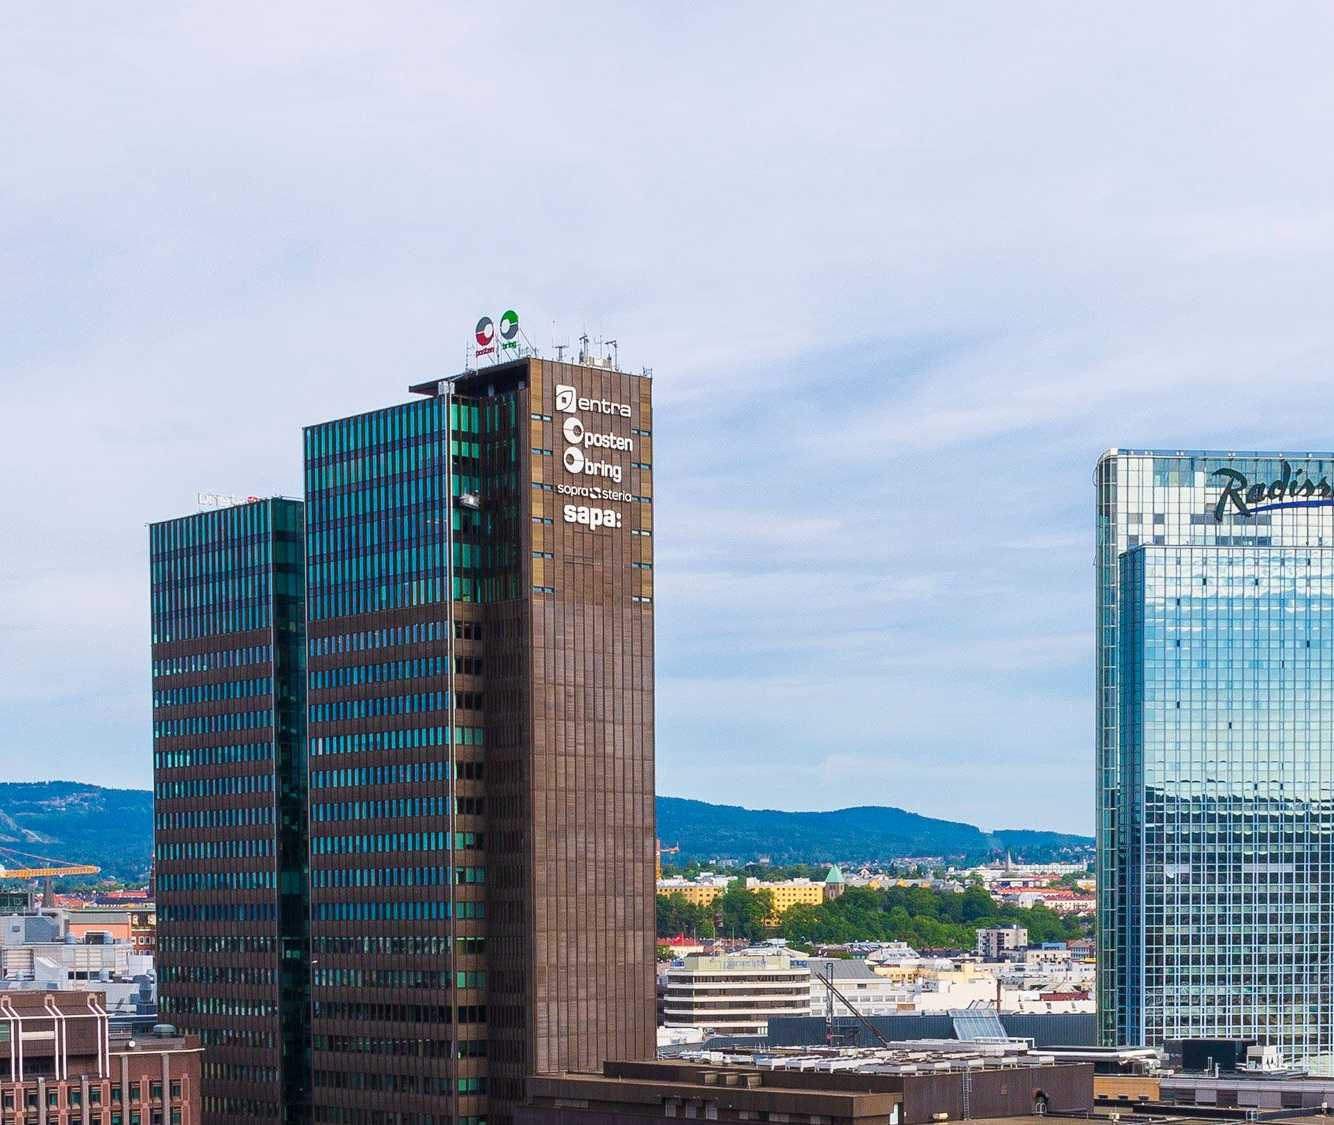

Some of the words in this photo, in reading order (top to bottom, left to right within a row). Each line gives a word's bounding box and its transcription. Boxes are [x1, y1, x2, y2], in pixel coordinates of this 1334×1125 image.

[578, 397, 631, 417] entra
[584, 432, 633, 452] posten
[584, 457, 622, 483] bring
[557, 484, 589, 497] sopra
[602, 489, 632, 503] steria
[564, 504, 622, 531] sapa:
